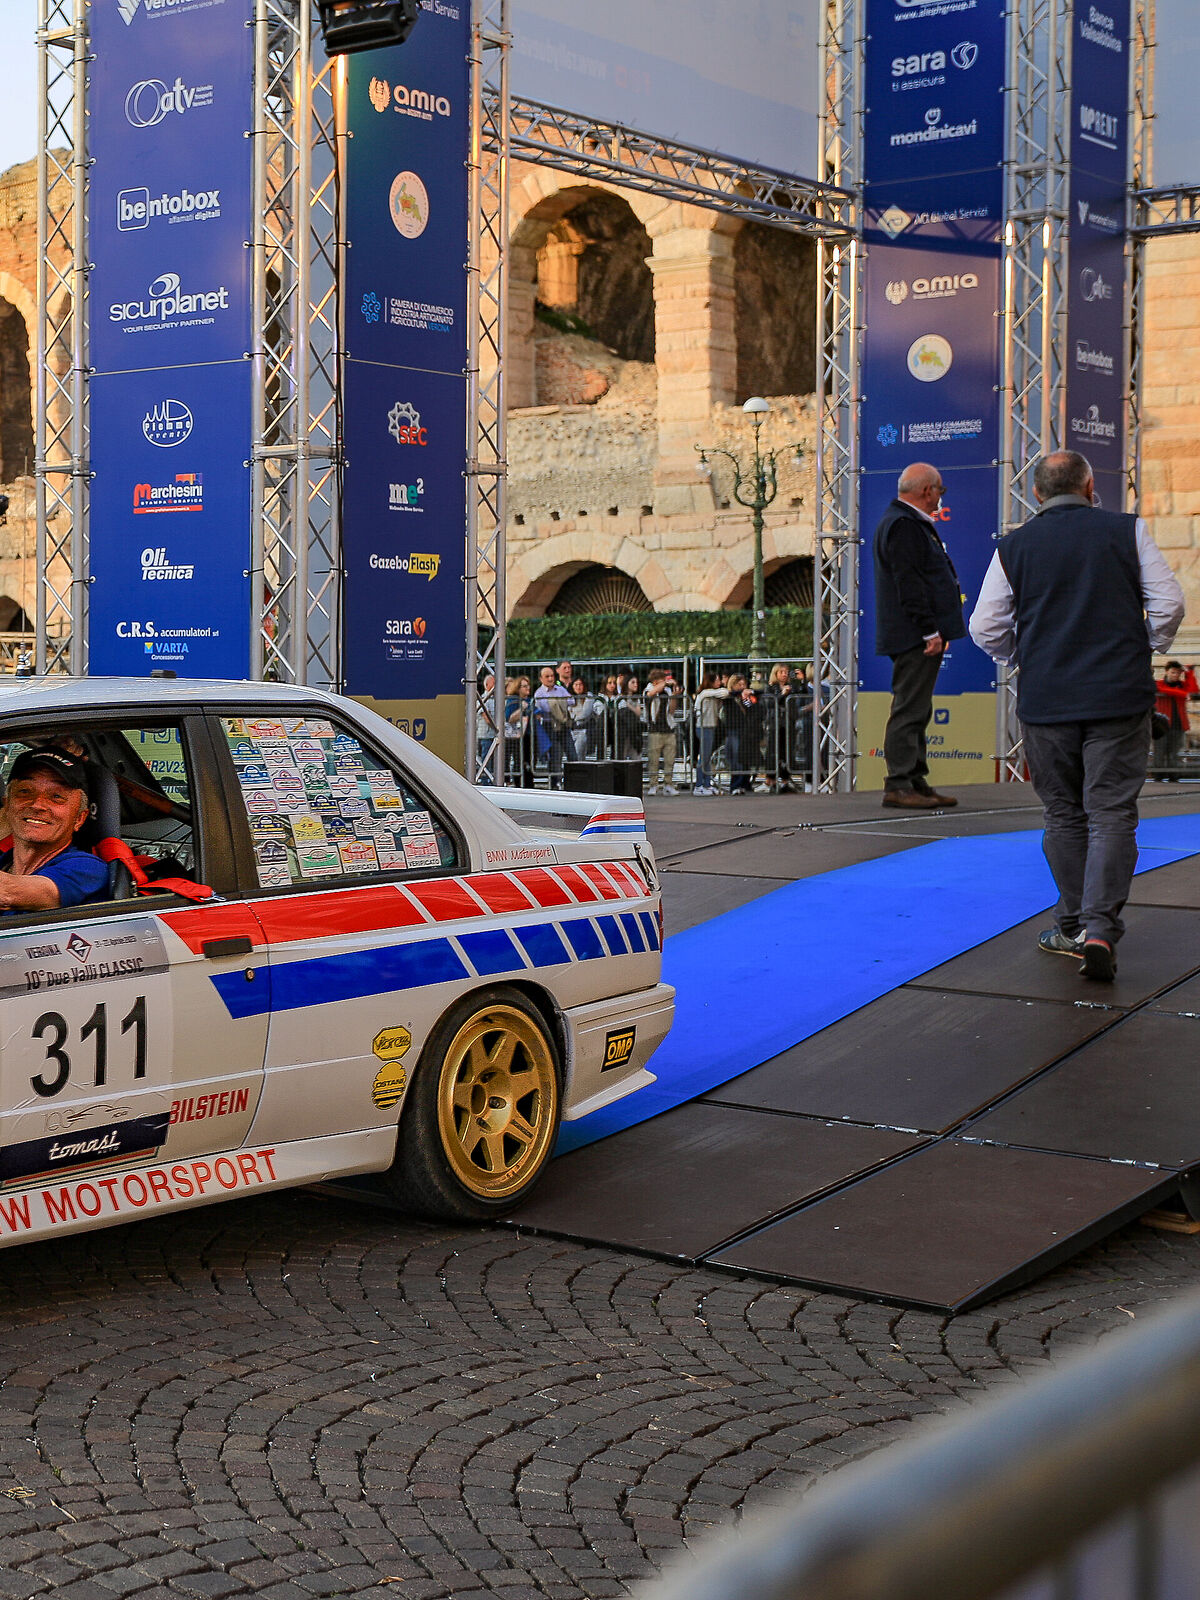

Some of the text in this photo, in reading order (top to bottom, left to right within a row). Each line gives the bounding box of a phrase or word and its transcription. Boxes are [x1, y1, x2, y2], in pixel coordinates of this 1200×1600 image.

[891, 50, 946, 77] sara
[160, 77, 196, 114] atv
[393, 85, 450, 117] amia
[890, 118, 978, 147] mondinicavi
[1080, 103, 1118, 139] UPRENT
[120, 189, 220, 222] bentobox
[911, 272, 979, 295] amia
[122, 317, 215, 334] YOUR SECURITY PARTNER
[399, 425, 428, 447] SEC
[133, 483, 203, 507] Marchesini
[141, 565, 195, 581] Tecnica
[116, 621, 159, 638] C.R.S.
[160, 626, 211, 638] accumulatori
[385, 619, 412, 635] sara
[155, 642, 190, 654] VARTA
[486, 847, 552, 864] BMW Motorsport
[47, 971, 70, 988] Due
[70, 963, 98, 983] Valli
[99, 957, 145, 979] CLASSIC
[30, 995, 146, 1098] 311
[607, 1038, 633, 1061] OMP
[169, 1088, 250, 1125] BILSTEIN
[49, 1130, 121, 1161] tomasi
[41, 1149, 278, 1225] MOTORSPORT
